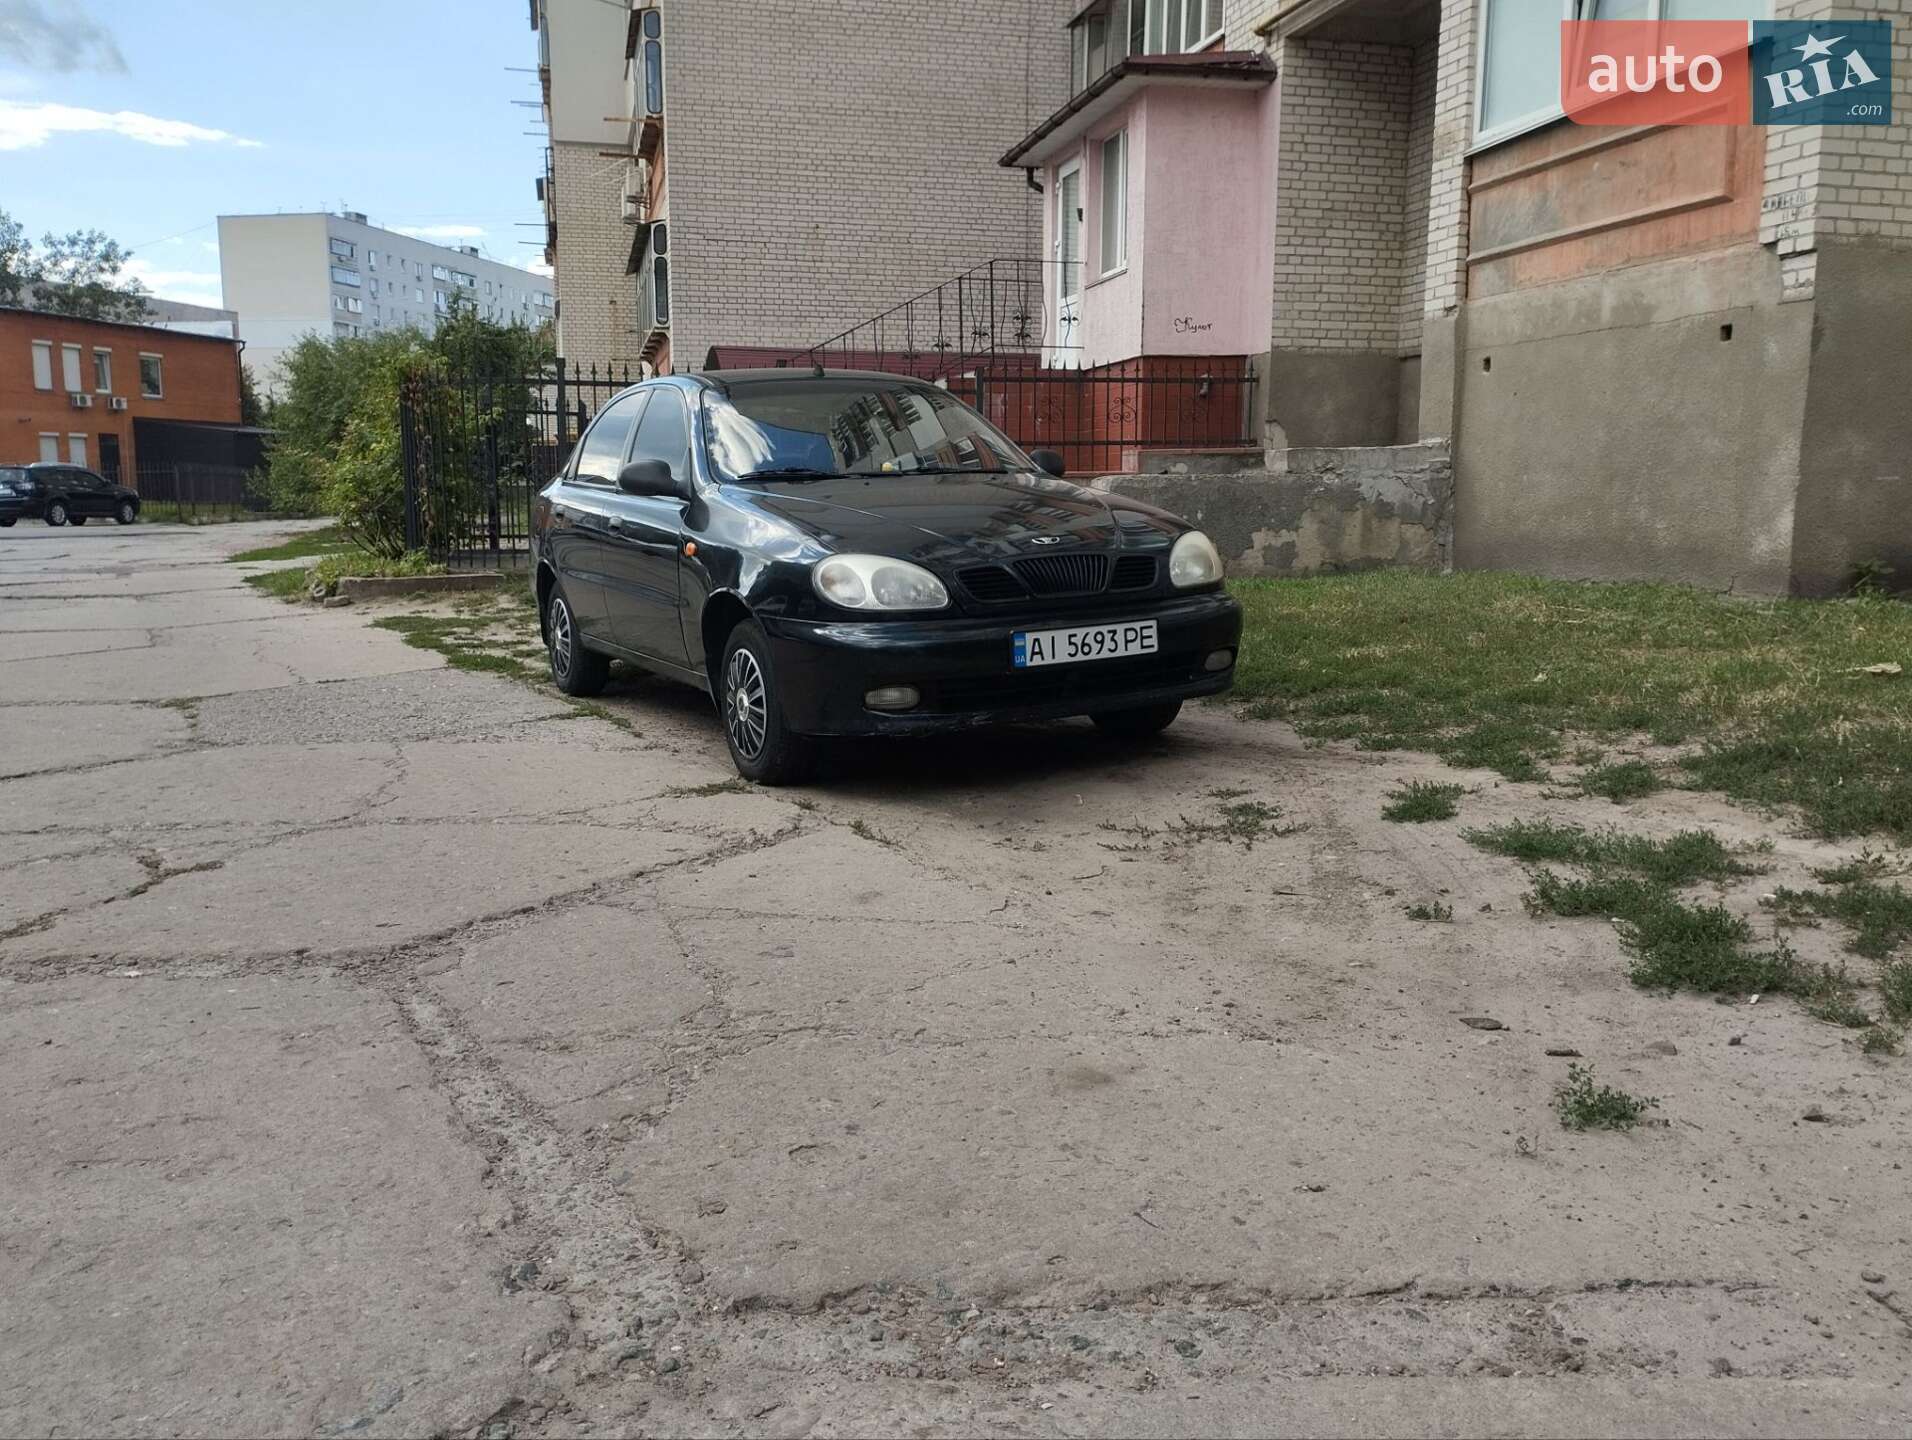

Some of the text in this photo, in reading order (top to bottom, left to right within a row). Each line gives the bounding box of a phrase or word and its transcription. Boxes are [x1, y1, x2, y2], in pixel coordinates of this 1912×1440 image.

[1030, 625, 1155, 662] AI 5693 PE
[1015, 655, 1025, 663] UA
